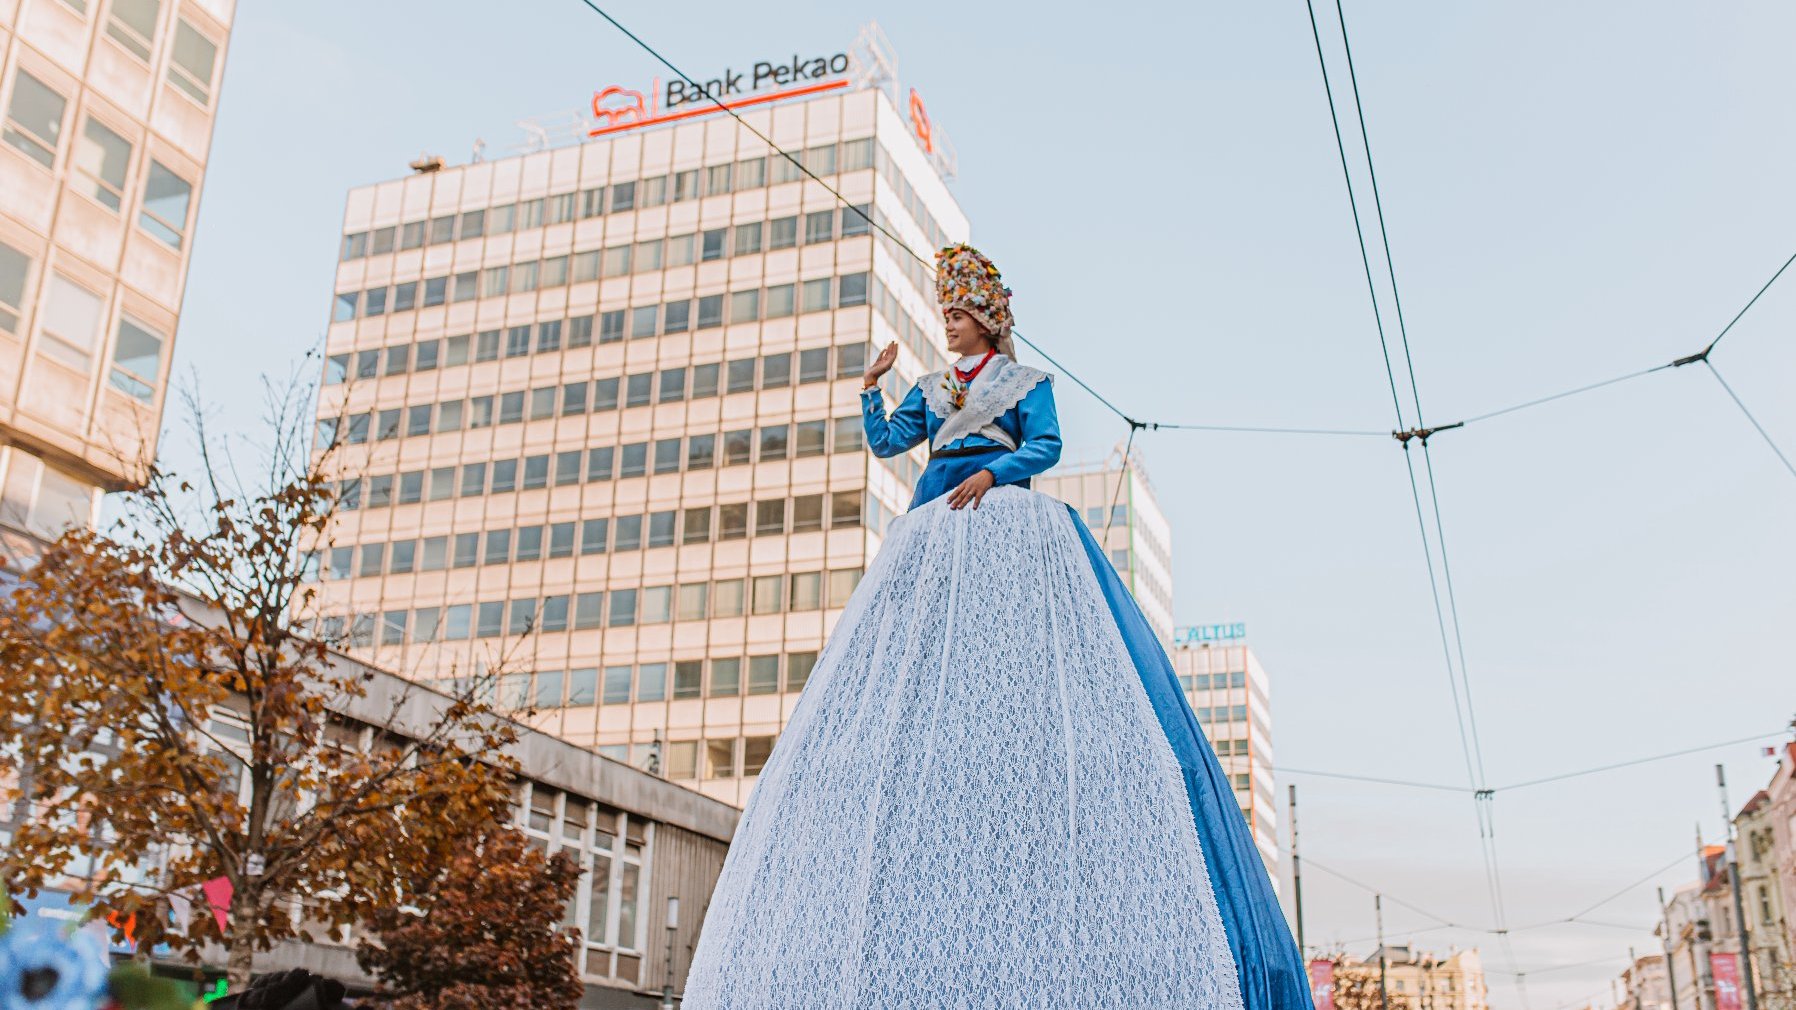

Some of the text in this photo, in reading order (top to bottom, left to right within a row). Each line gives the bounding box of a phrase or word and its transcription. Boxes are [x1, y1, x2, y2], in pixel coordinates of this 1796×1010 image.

[666, 53, 848, 108] Bank Pekao
[1187, 623, 1246, 641] ALTUS
